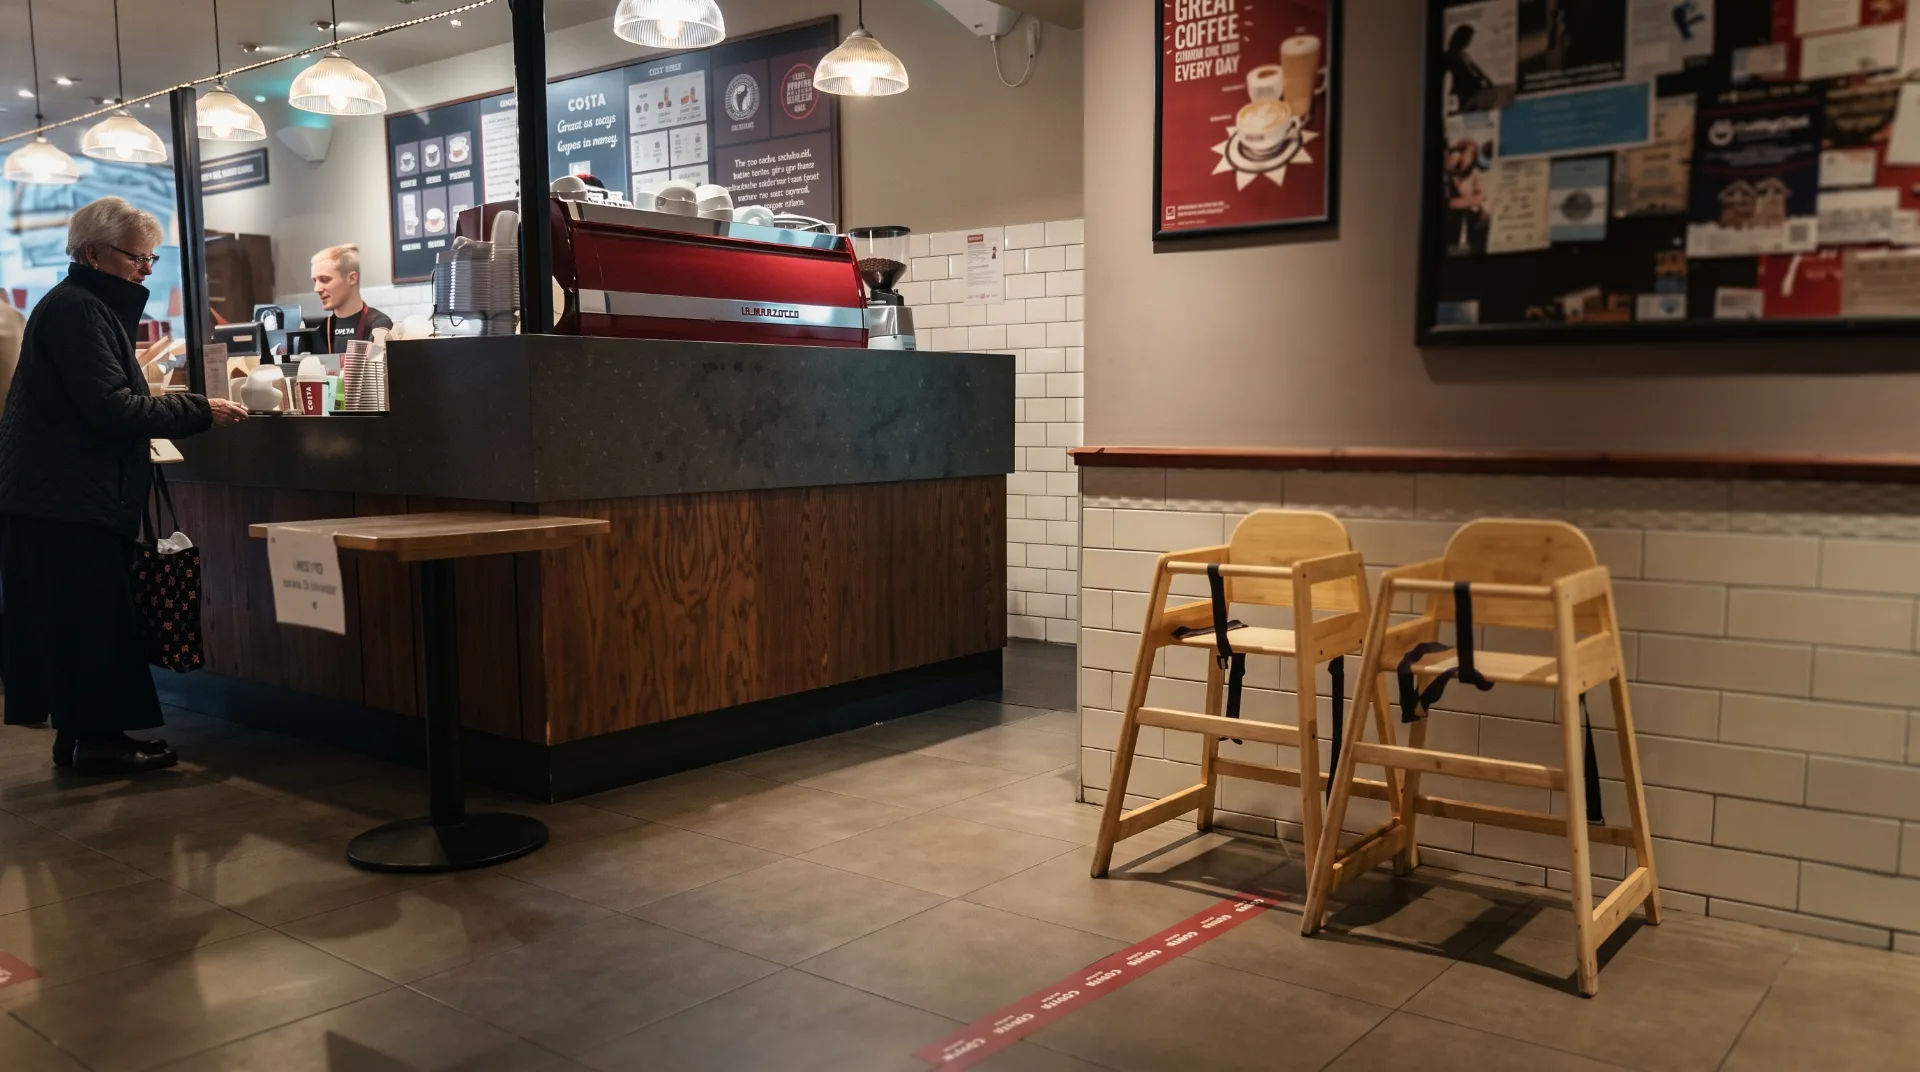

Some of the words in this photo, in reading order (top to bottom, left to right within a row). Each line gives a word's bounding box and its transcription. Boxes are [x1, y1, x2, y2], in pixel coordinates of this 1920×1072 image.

[1174, 13, 1240, 50] COFFEE
[1174, 59, 1213, 82] EVERY
[1215, 54, 1240, 76] DAY
[567, 92, 607, 112] COSTA
